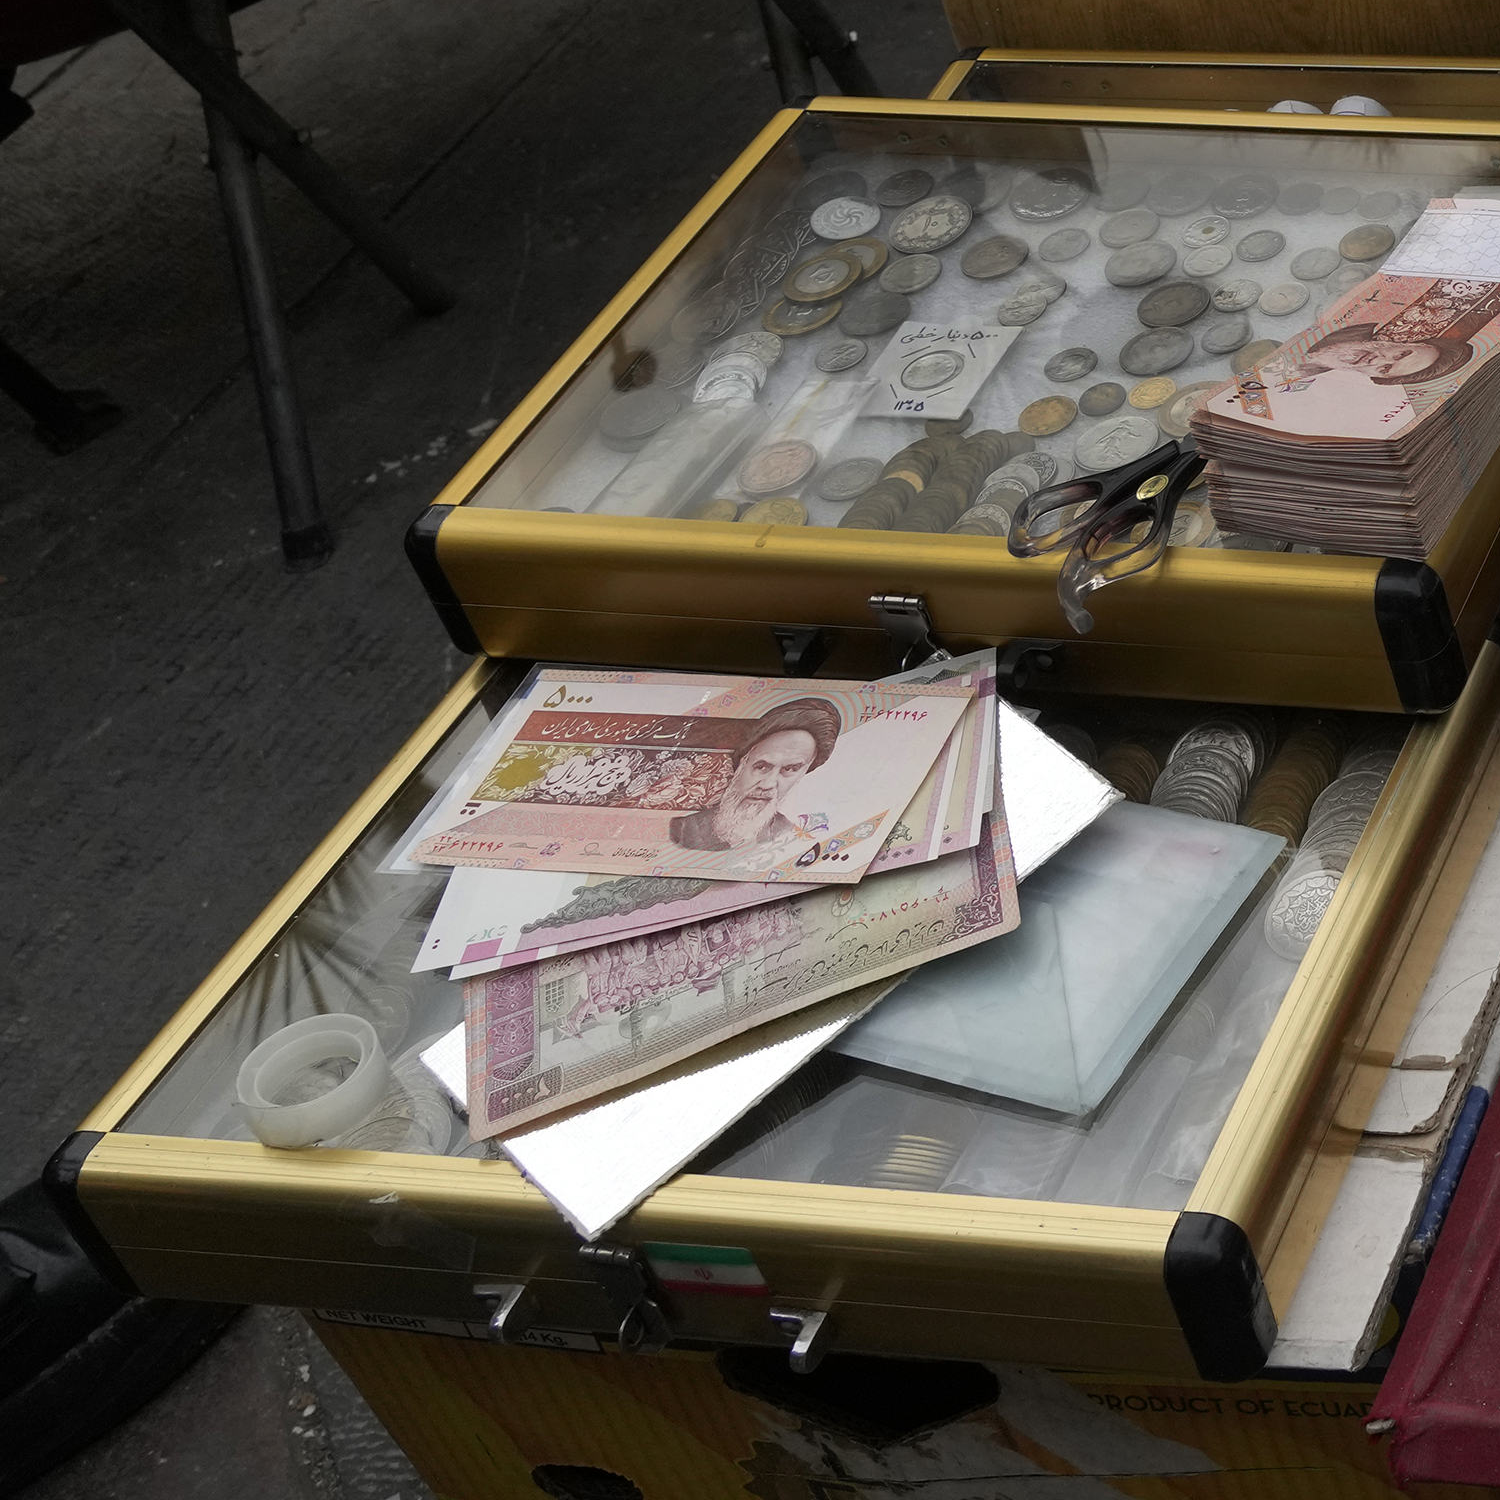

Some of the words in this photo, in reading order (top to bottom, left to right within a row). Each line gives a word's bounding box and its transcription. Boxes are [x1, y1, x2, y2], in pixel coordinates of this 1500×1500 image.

[542, 684, 594, 709] ۵۰۰۰
[541, 717, 578, 740] ایران
[564, 716, 611, 739] اسلامی
[594, 718, 638, 742] جمهوری
[625, 716, 669, 741] مرکزی
[653, 719, 699, 746] بانک
[794, 841, 850, 868] ۵۰۰۰
[325, 1308, 357, 1322] NET
[358, 1310, 426, 1329] WEIGHT
[1235, 1397, 1275, 1416] OF
